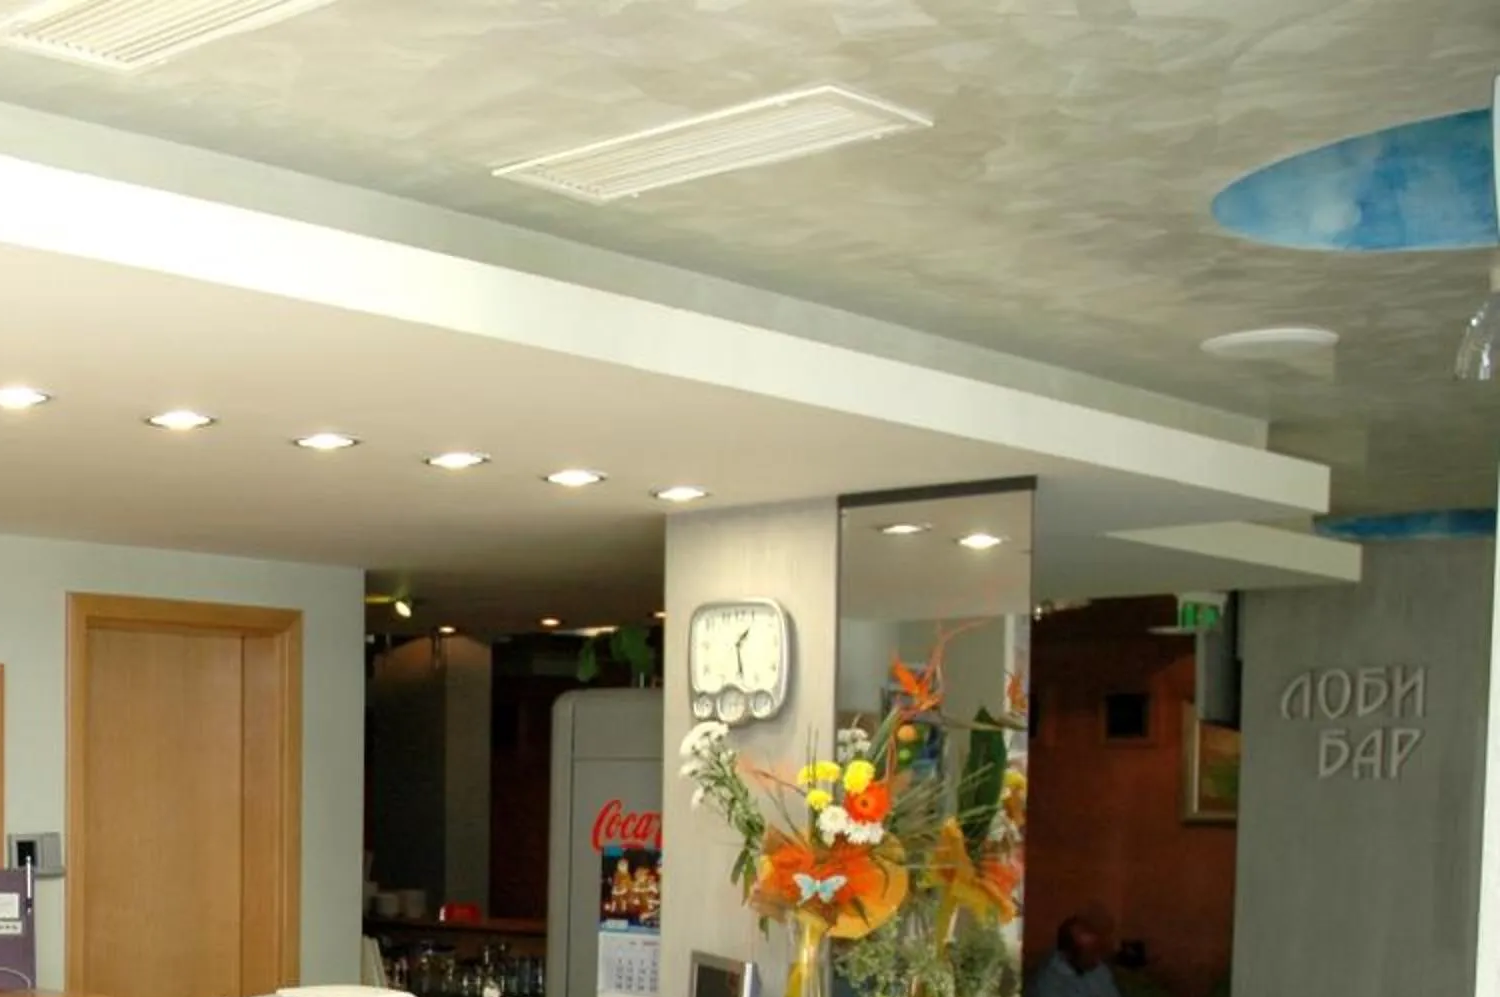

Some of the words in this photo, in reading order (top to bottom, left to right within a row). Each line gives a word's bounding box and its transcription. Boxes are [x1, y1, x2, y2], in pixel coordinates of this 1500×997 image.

[1280, 666, 1426, 720] ЛОБИ
[1318, 728, 1425, 781] БАР
[592, 799, 662, 854] Coca
